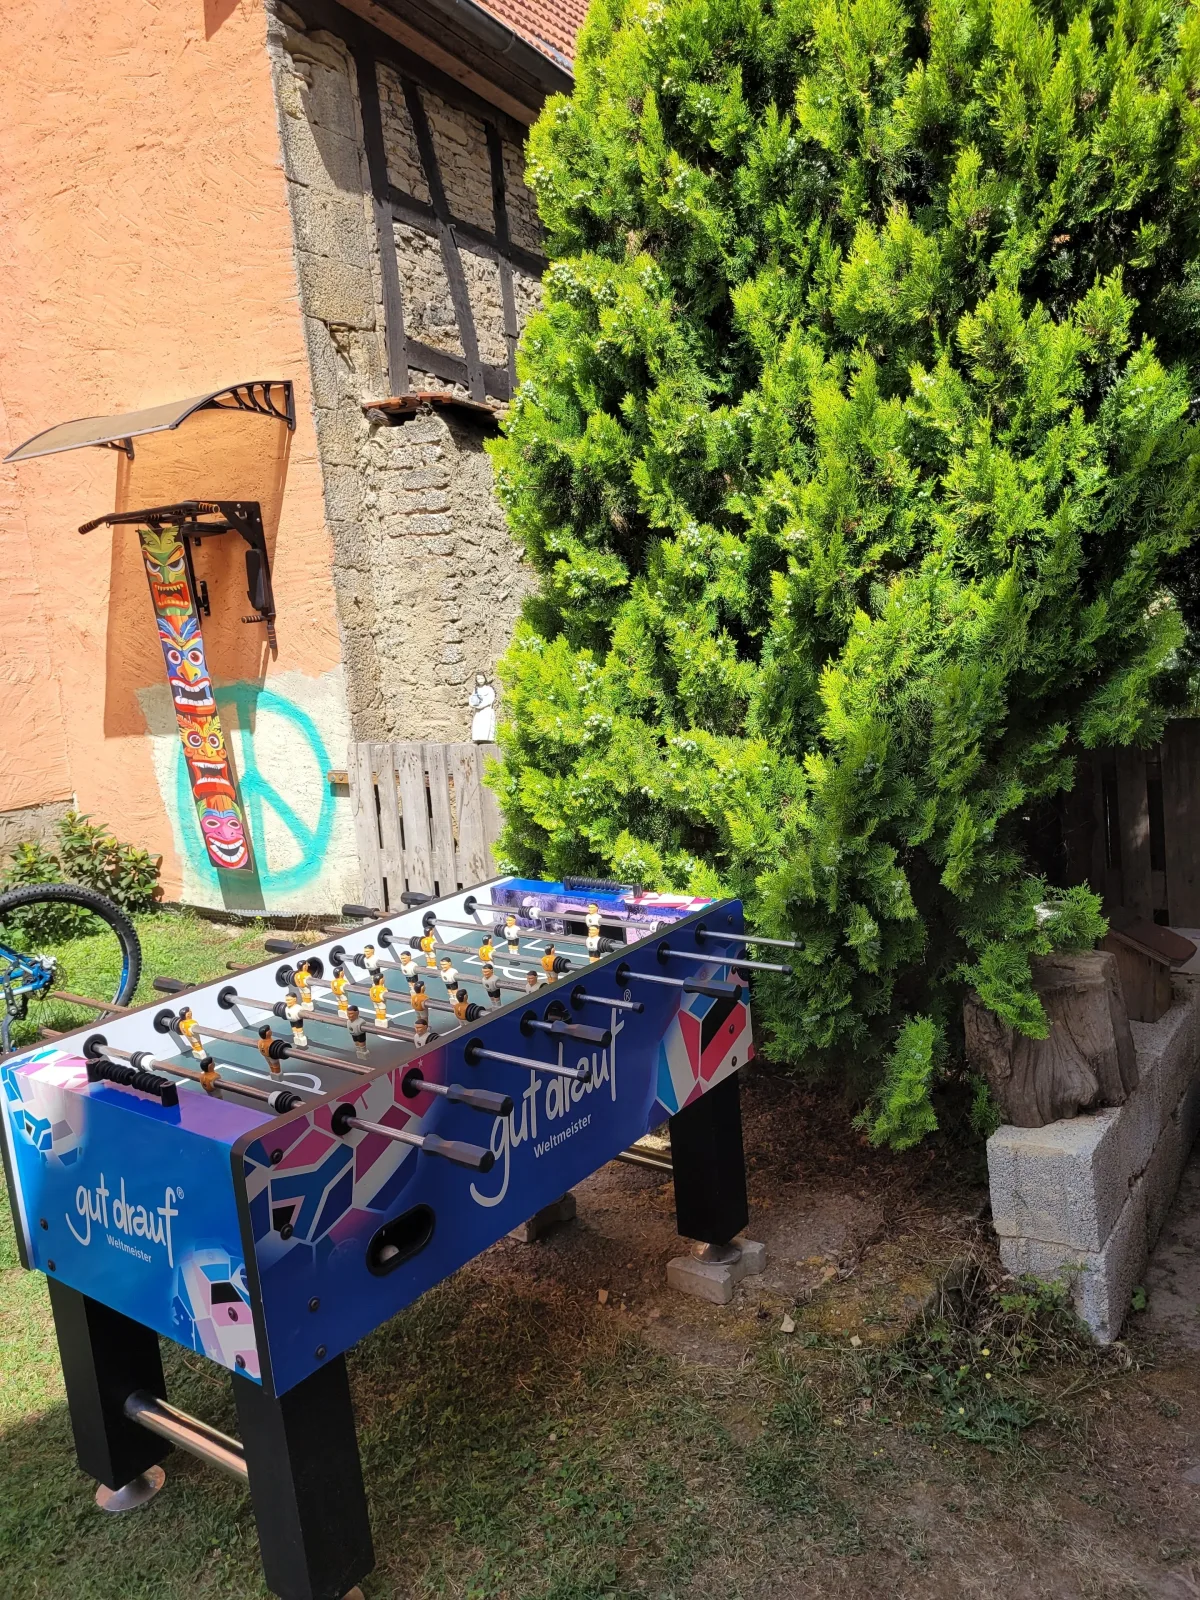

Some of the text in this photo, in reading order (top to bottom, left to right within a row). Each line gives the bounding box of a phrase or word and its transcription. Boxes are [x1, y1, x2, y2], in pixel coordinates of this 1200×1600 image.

[470, 1070, 542, 1207] gut
[533, 1114, 592, 1158] Weltmeister
[66, 1173, 109, 1246] gut
[106, 1234, 152, 1263] Weltmeister
